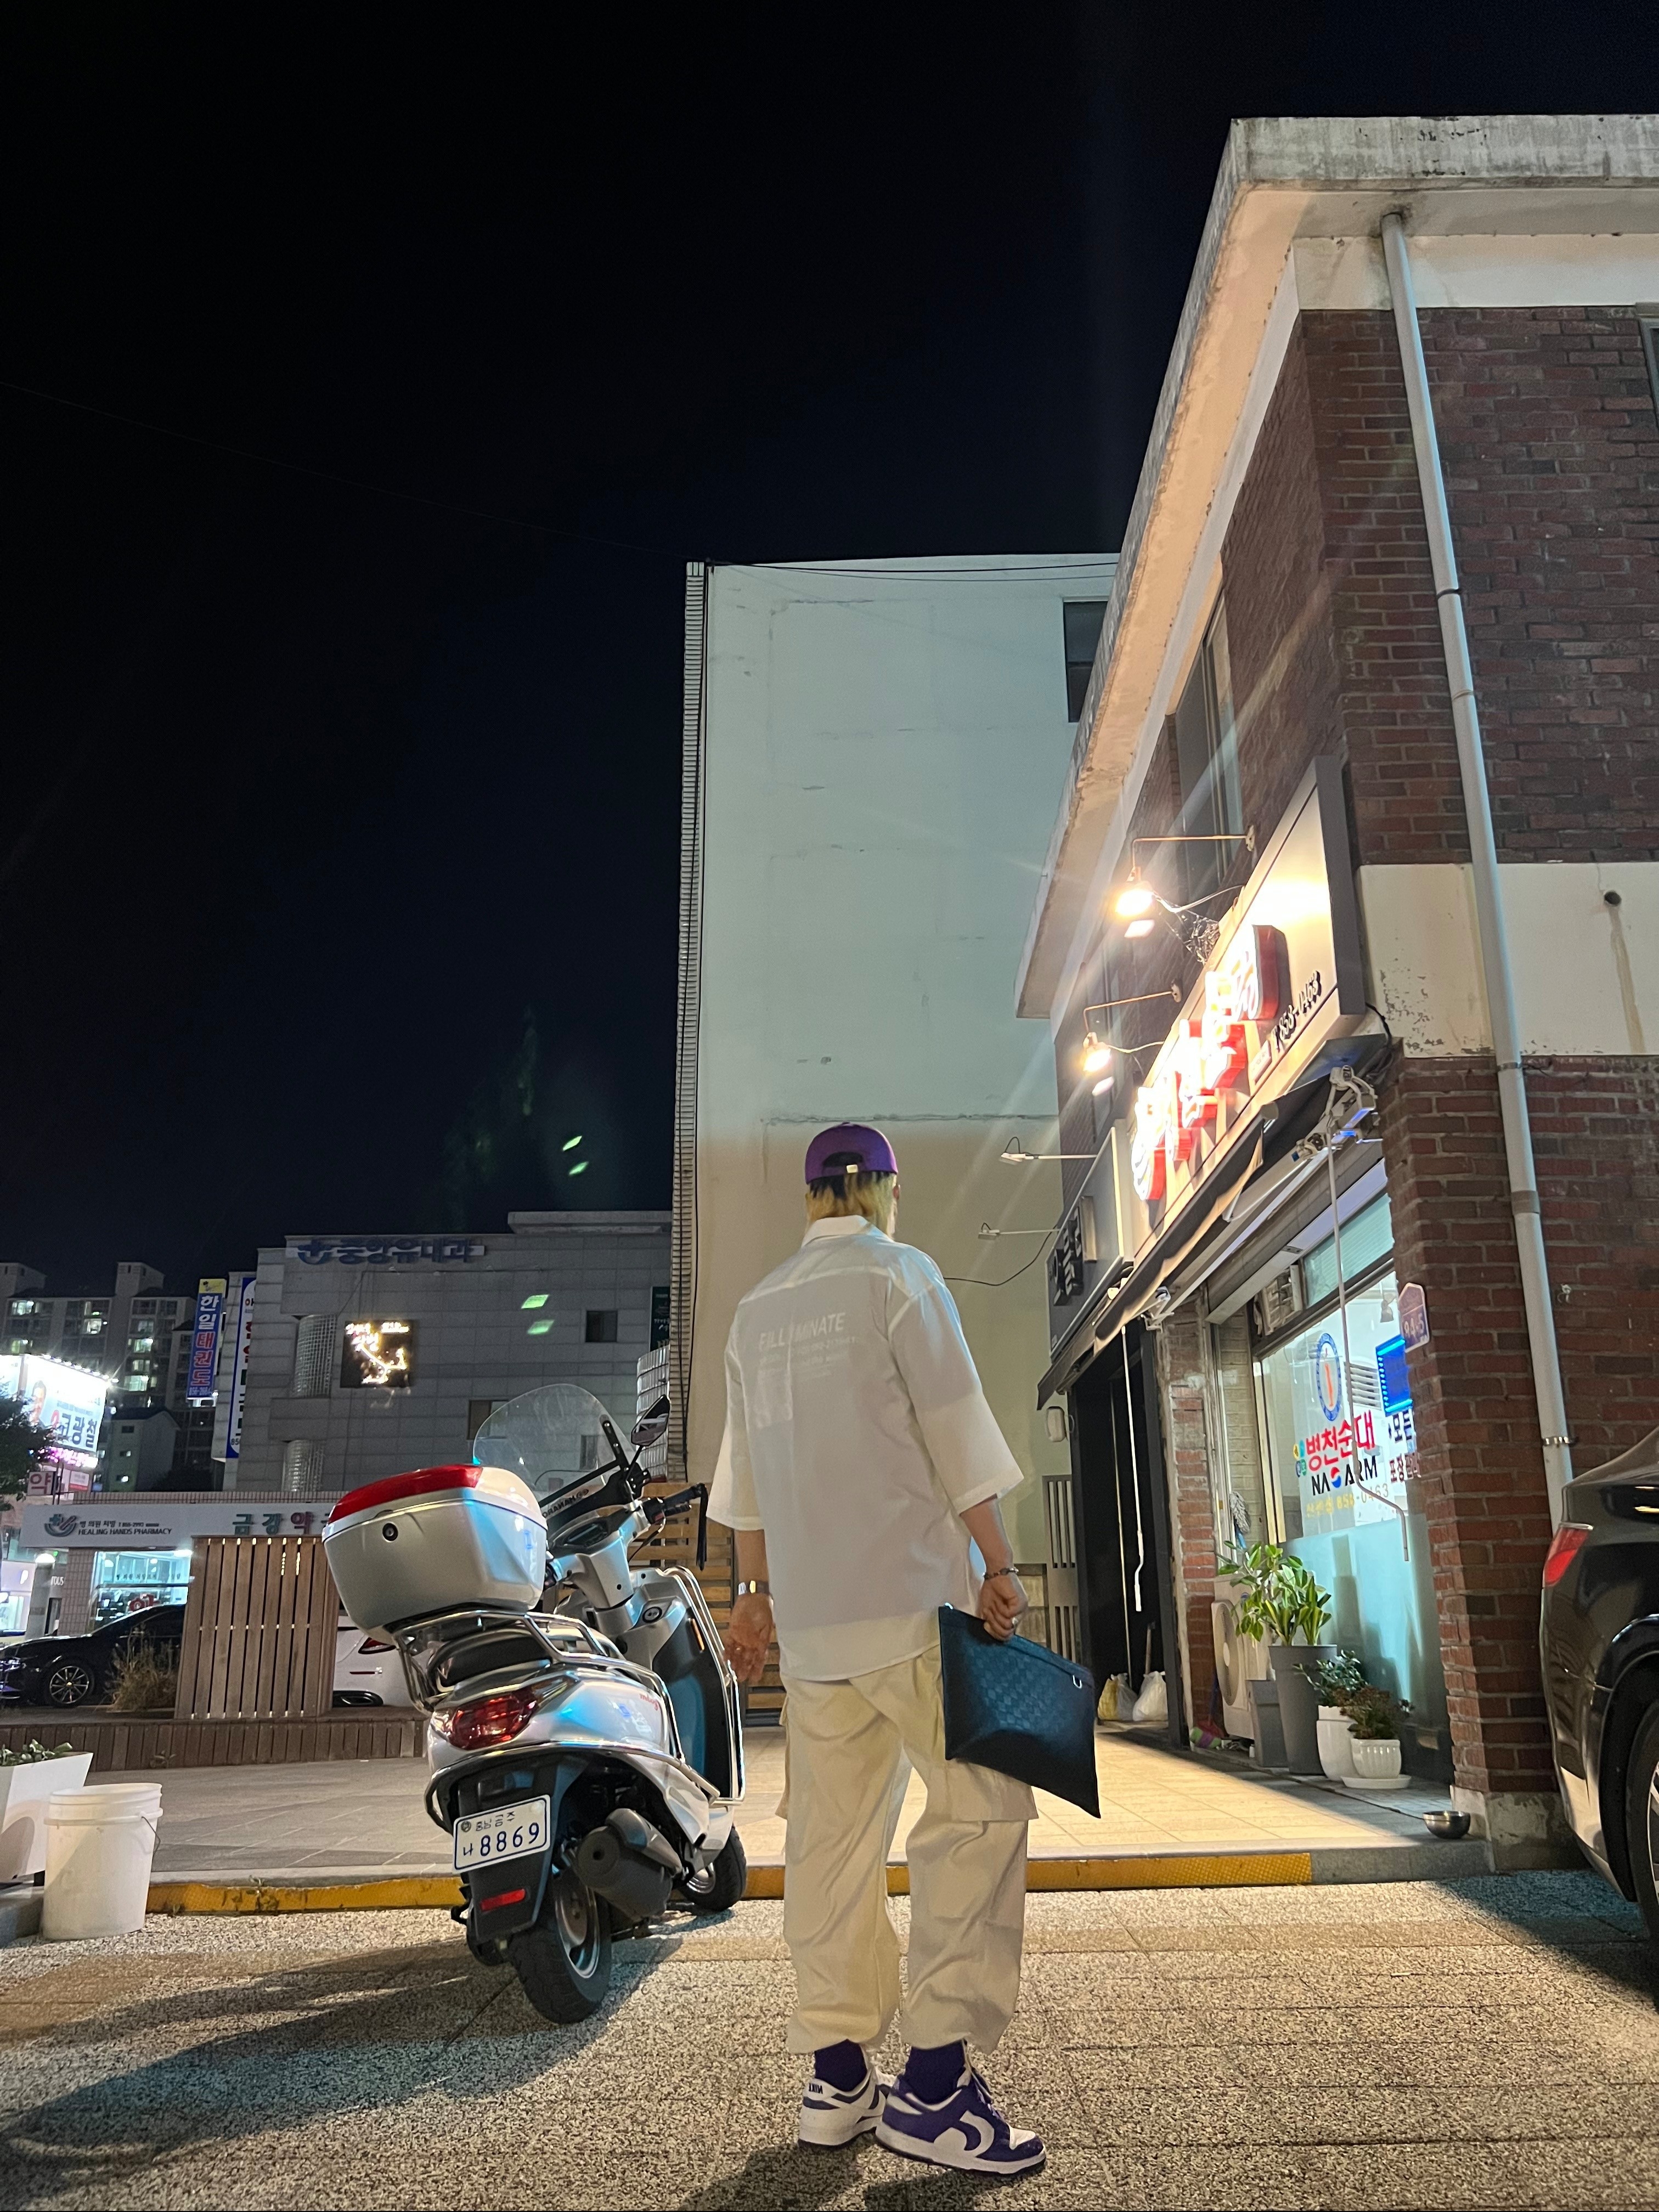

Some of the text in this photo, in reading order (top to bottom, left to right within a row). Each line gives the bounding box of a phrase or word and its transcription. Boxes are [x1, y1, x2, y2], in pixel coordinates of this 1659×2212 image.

[1306, 1409, 1376, 1471] 병천순대
[463, 1822, 539, 1857] 나 8869
